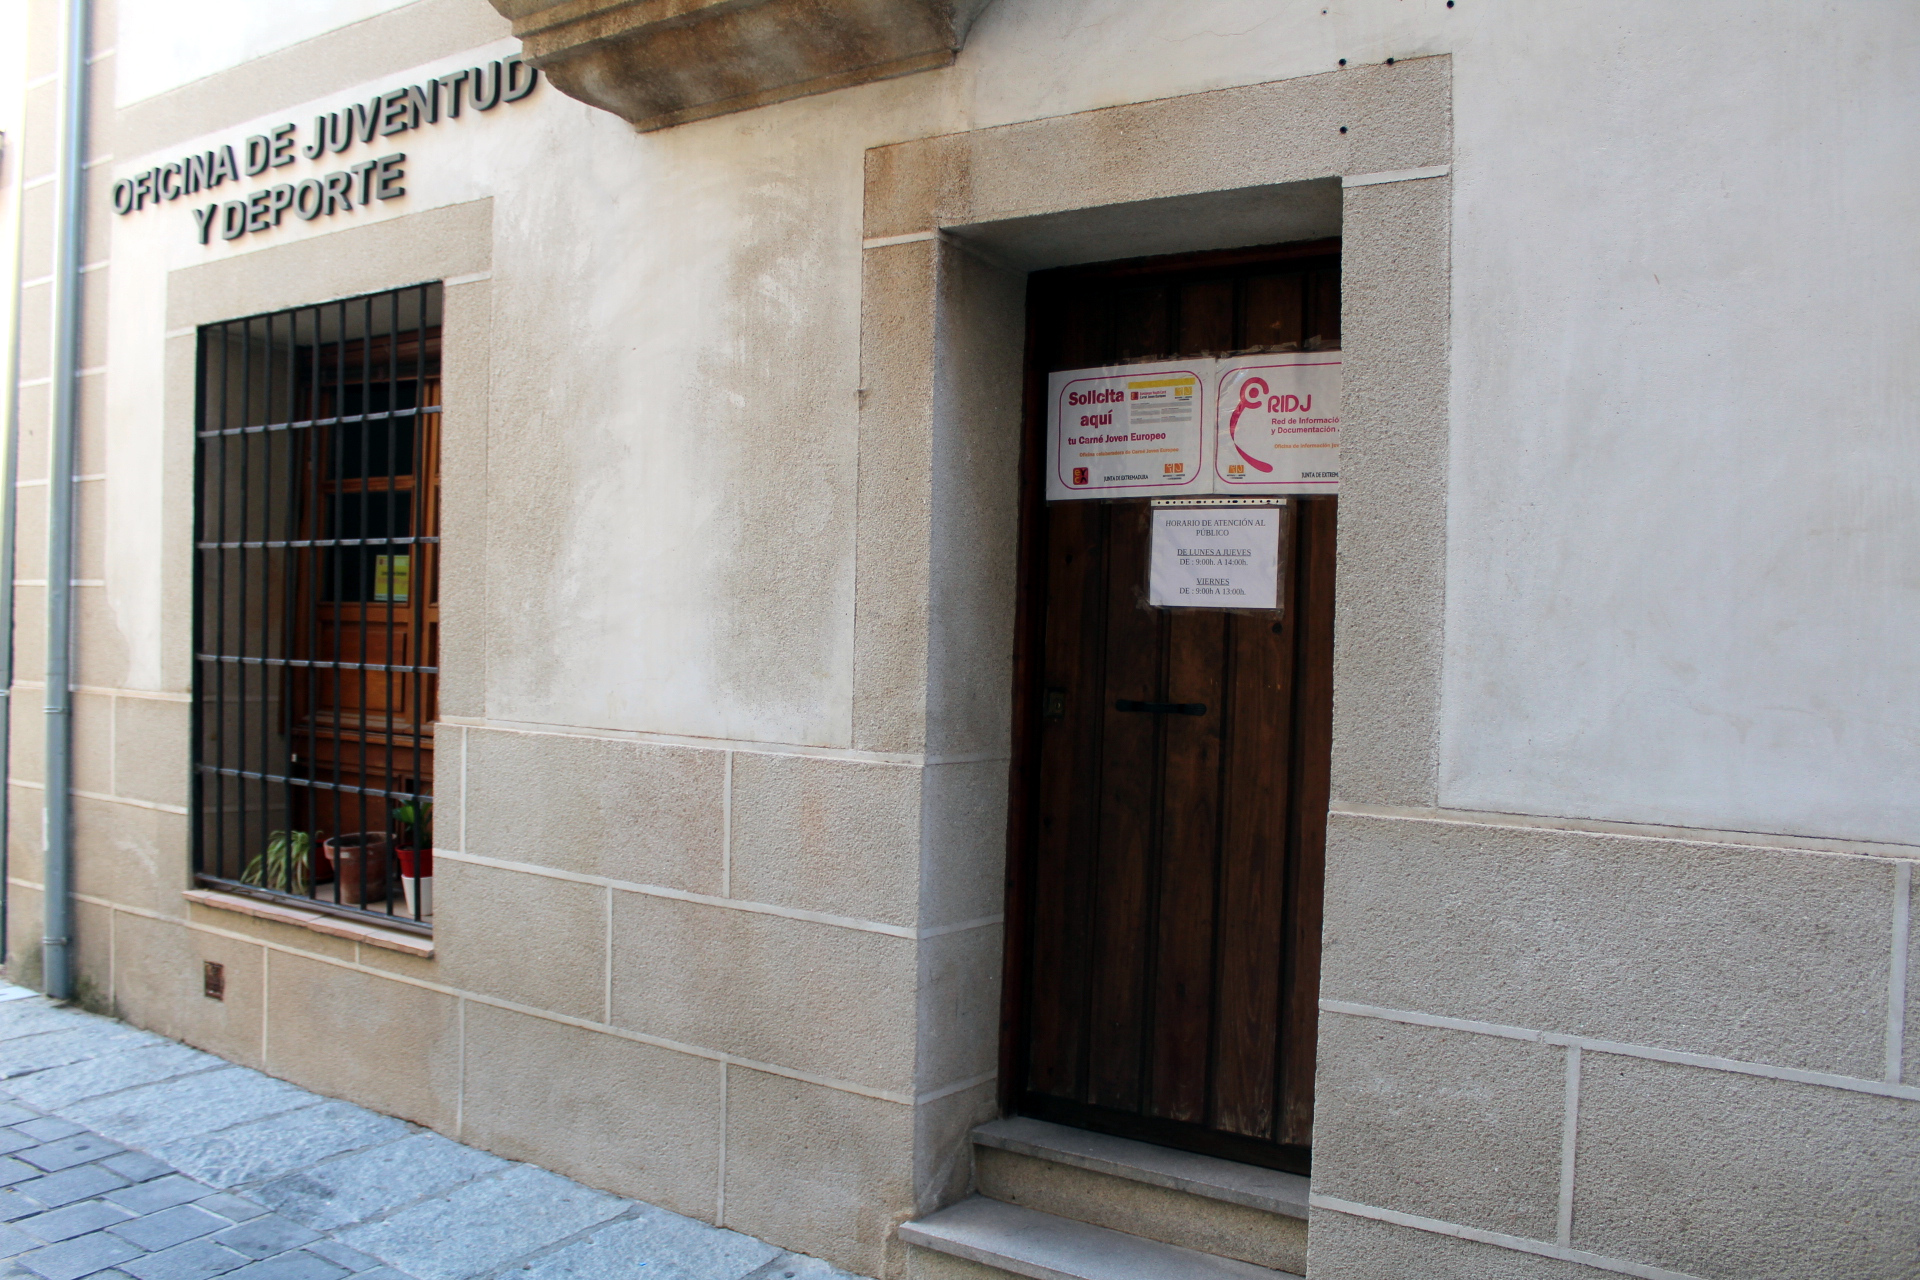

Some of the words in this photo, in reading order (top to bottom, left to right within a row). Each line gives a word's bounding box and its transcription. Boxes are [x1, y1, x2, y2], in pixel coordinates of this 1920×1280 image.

[111, 144, 238, 217] OFICINA
[244, 123, 296, 177] DE
[302, 53, 538, 160] JUVENTUD
[193, 203, 218, 245] Y
[221, 152, 406, 241] DEPORTE
[1068, 389, 1124, 406] Solicita
[1268, 394, 1312, 413] RIDJ
[1080, 410, 1113, 428] aquí
[1079, 435, 1103, 444] Carné
[1105, 434, 1128, 443] Joven
[1131, 432, 1166, 442] Europeo
[1214, 518, 1253, 526] ATENCIÓN
[1196, 528, 1229, 536] PÚBLICO
